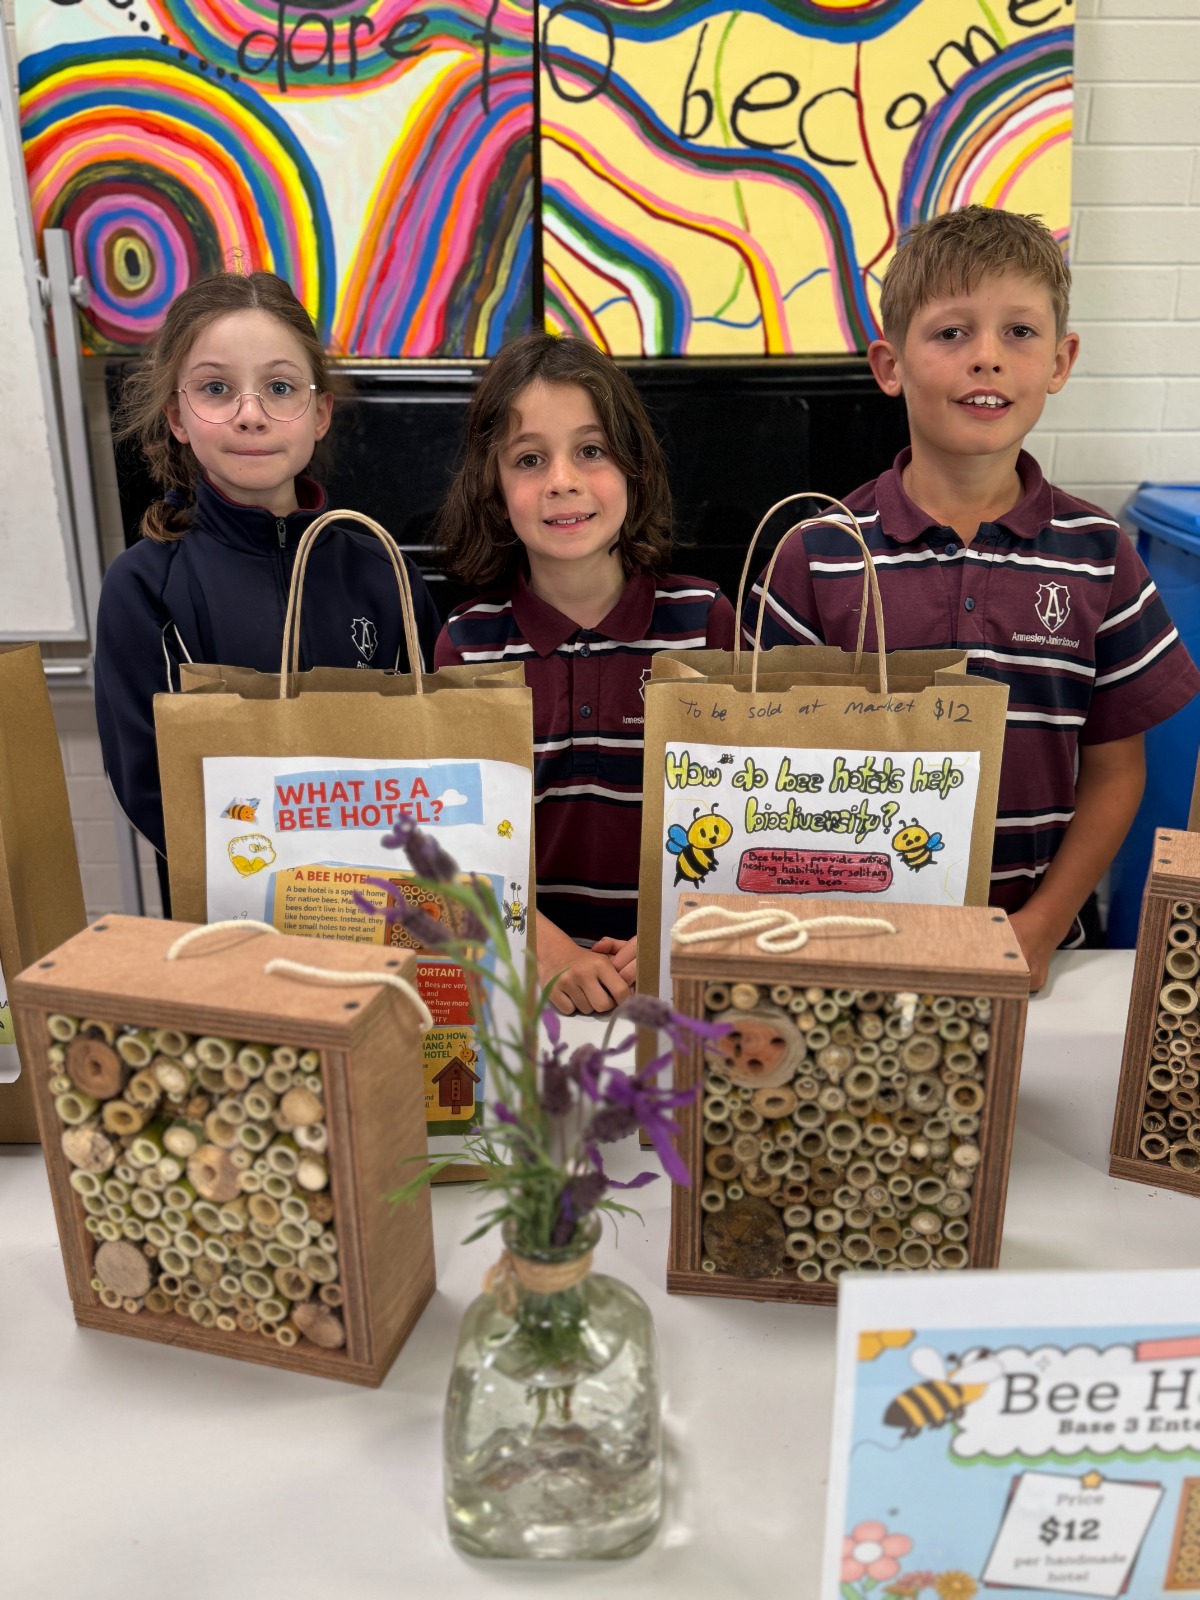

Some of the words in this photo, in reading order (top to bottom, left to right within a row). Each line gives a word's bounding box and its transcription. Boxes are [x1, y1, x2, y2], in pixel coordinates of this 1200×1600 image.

[237, 0, 432, 93] dare
[1012, 631, 1046, 645] Annesley
[679, 698, 701, 718] To
[712, 702, 727, 720] be
[748, 701, 783, 718] sold
[799, 700, 825, 714] at
[933, 698, 972, 722] $12
[665, 750, 722, 789] How
[732, 757, 768, 791] do
[775, 756, 824, 793] bee
[829, 756, 905, 794] hotels
[910, 757, 964, 800] help
[276, 780, 365, 806] WHAT
[374, 779, 401, 802] IS
[410, 777, 430, 799] A
[278, 806, 332, 831] BEE
[749, 851, 769, 861] Bee
[771, 851, 804, 863] hotels
[810, 855, 854, 867] provide
[295, 870, 304, 881] A
[307, 871, 330, 882] BEE
[334, 872, 369, 884] HOTE
[743, 861, 777, 877] nesting
[782, 863, 825, 875] habitats
[827, 865, 848, 877] for
[848, 867, 887, 882] solitary
[777, 877, 811, 885] native
[308, 886, 327, 894] hotel
[366, 889, 386, 897] home
[298, 895, 320, 903] native
[321, 896, 340, 904] bees.
[345, 906, 356, 915] big
[299, 913, 338, 922] honeybees.
[340, 915, 367, 924] Instead,
[368, 917, 384, 925] they
[284, 921, 297, 929] like
[298, 922, 318, 930] small
[319, 923, 338, 931] holes
[336, 933, 354, 941] hotel
[355, 934, 374, 942] gives
[424, 980, 440, 989] Bees
[453, 983, 467, 991] very
[435, 998, 451, 1006] have
[425, 1033, 444, 1041] AND
[446, 1032, 467, 1040] HOW
[446, 1041, 453, 1049] A
[424, 1051, 451, 1059] HOTEL
[999, 1371, 1121, 1415] Bee
[1145, 1368, 1200, 1412] H
[1057, 1418, 1117, 1435] Base
[1123, 1418, 1139, 1434] 3
[1056, 1493, 1104, 1506] Price
[1039, 1515, 1101, 1546] $12
